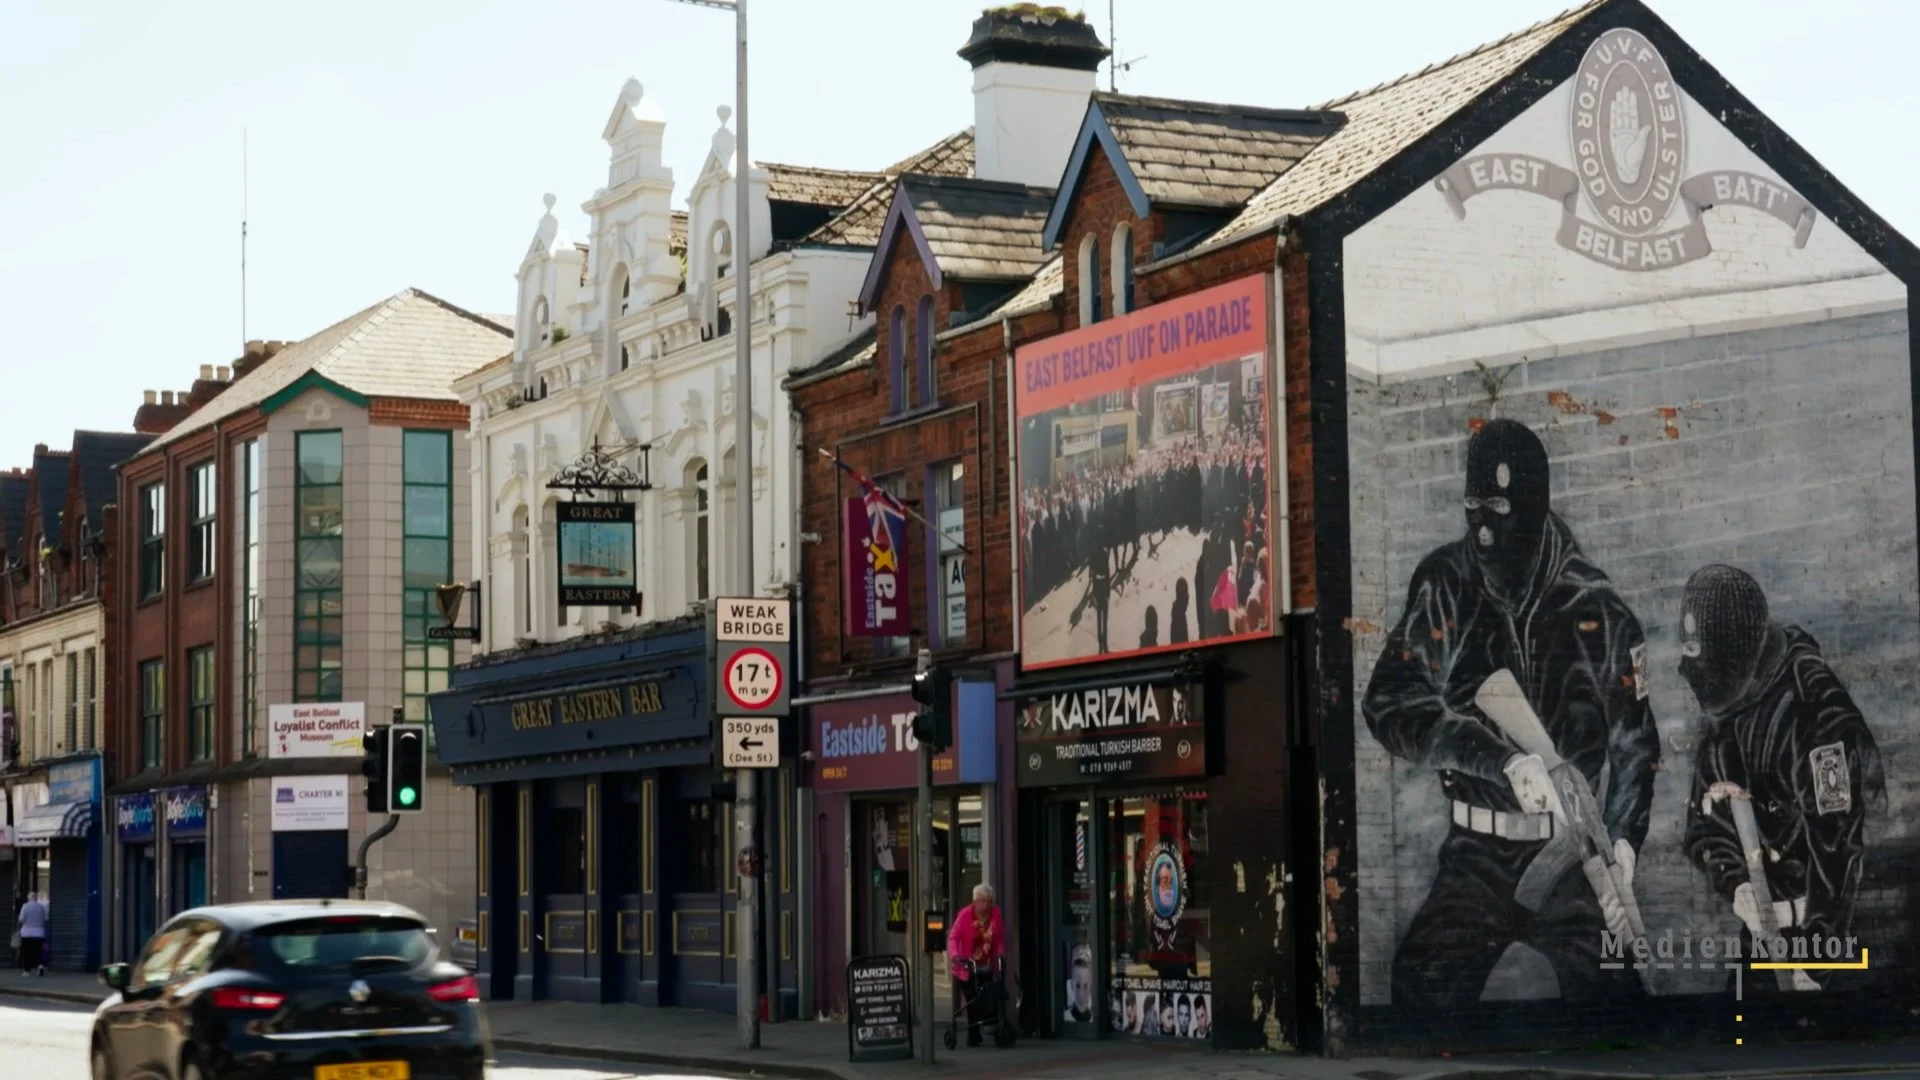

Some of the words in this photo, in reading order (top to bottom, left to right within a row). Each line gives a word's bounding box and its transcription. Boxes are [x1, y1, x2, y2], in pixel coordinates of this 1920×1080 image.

[1576, 72, 1599, 129] FOR
[1653, 80, 1679, 202] ULSTER
[1470, 158, 1546, 188] EAST
[1578, 139, 1606, 198] GOD
[1607, 207, 1654, 228] AND
[1575, 226, 1690, 268] BELFAST
[1026, 353, 1059, 393] EAST
[1063, 335, 1122, 381] BELFAST
[1127, 325, 1155, 363] UVF
[1159, 315, 1181, 355] ON
[1185, 296, 1252, 345] PARADE
[570, 506, 623, 520] GREAT
[564, 588, 632, 601] EASTERN
[864, 566, 875, 628] Eastside
[731, 604, 777, 619] WEAK
[723, 621, 785, 636] BRIDGE
[736, 663, 760, 683] 17
[764, 664, 771, 679] t
[293, 708, 310, 718] East
[313, 707, 341, 717] Belfast
[511, 701, 553, 731] GREAT
[560, 687, 623, 725] EASTERN
[631, 681, 664, 715] BAR
[1052, 683, 1161, 731] KARIZMA
[274, 719, 315, 733] Loyalist
[318, 719, 360, 731] Conflict
[727, 722, 752, 734] 350
[754, 722, 775, 735] yds
[821, 713, 887, 758] Eastside
[300, 732, 334, 742] Museum
[1056, 742, 1100, 760] TRADITIONAL
[1100, 739, 1131, 757] TURKISH
[1131, 736, 1162, 753] BARBER
[298, 790, 332, 799] CHARTER
[853, 966, 901, 979] KARIZMA
[1111, 978, 1122, 988] HOT
[1124, 978, 1142, 989] TOWEL
[1143, 978, 1162, 990] SHAVE
[1163, 979, 1188, 991] HAIRCUT
[1190, 980, 1203, 991] HAIR
